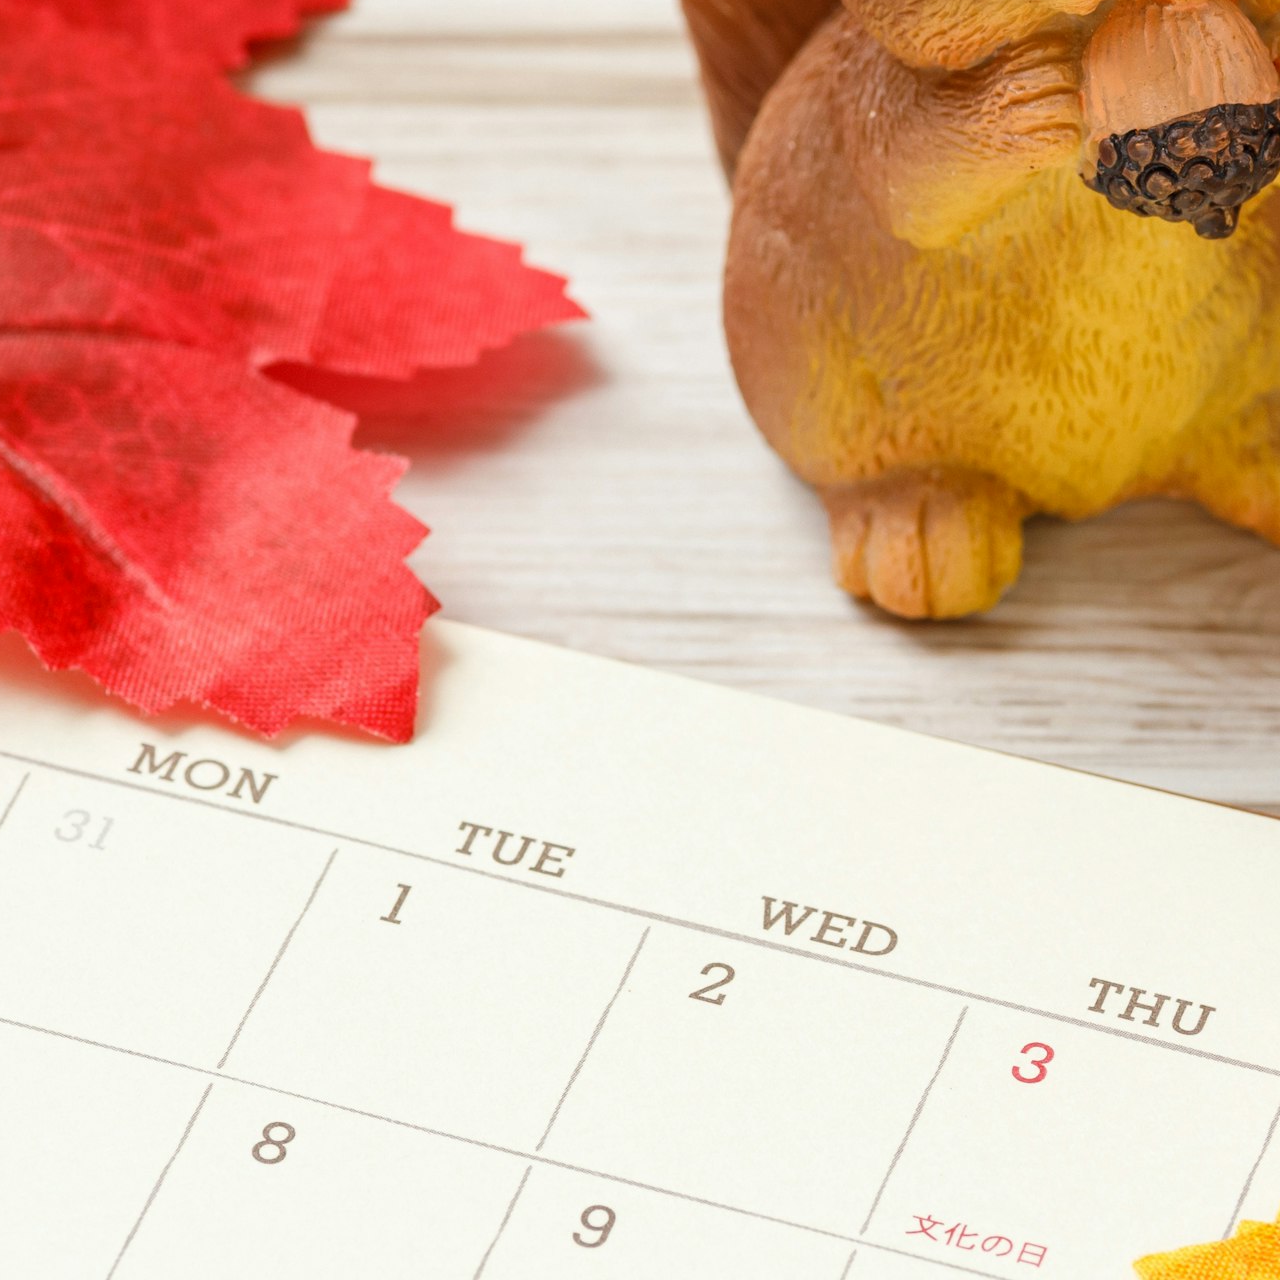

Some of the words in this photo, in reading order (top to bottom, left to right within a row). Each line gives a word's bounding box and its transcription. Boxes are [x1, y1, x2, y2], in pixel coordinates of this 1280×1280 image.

[53, 809, 115, 851] 31
[380, 883, 412, 925] 1
[688, 962, 736, 1006] 2
[1011, 1042, 1055, 1085] 3
[127, 743, 279, 804] MON
[453, 821, 577, 880] TUE
[756, 896, 899, 959] WED
[1086, 977, 1217, 1039] THU
[252, 1121, 297, 1165] 8
[572, 1205, 617, 1249] 9
[905, 1214, 1048, 1268] 文化の日
